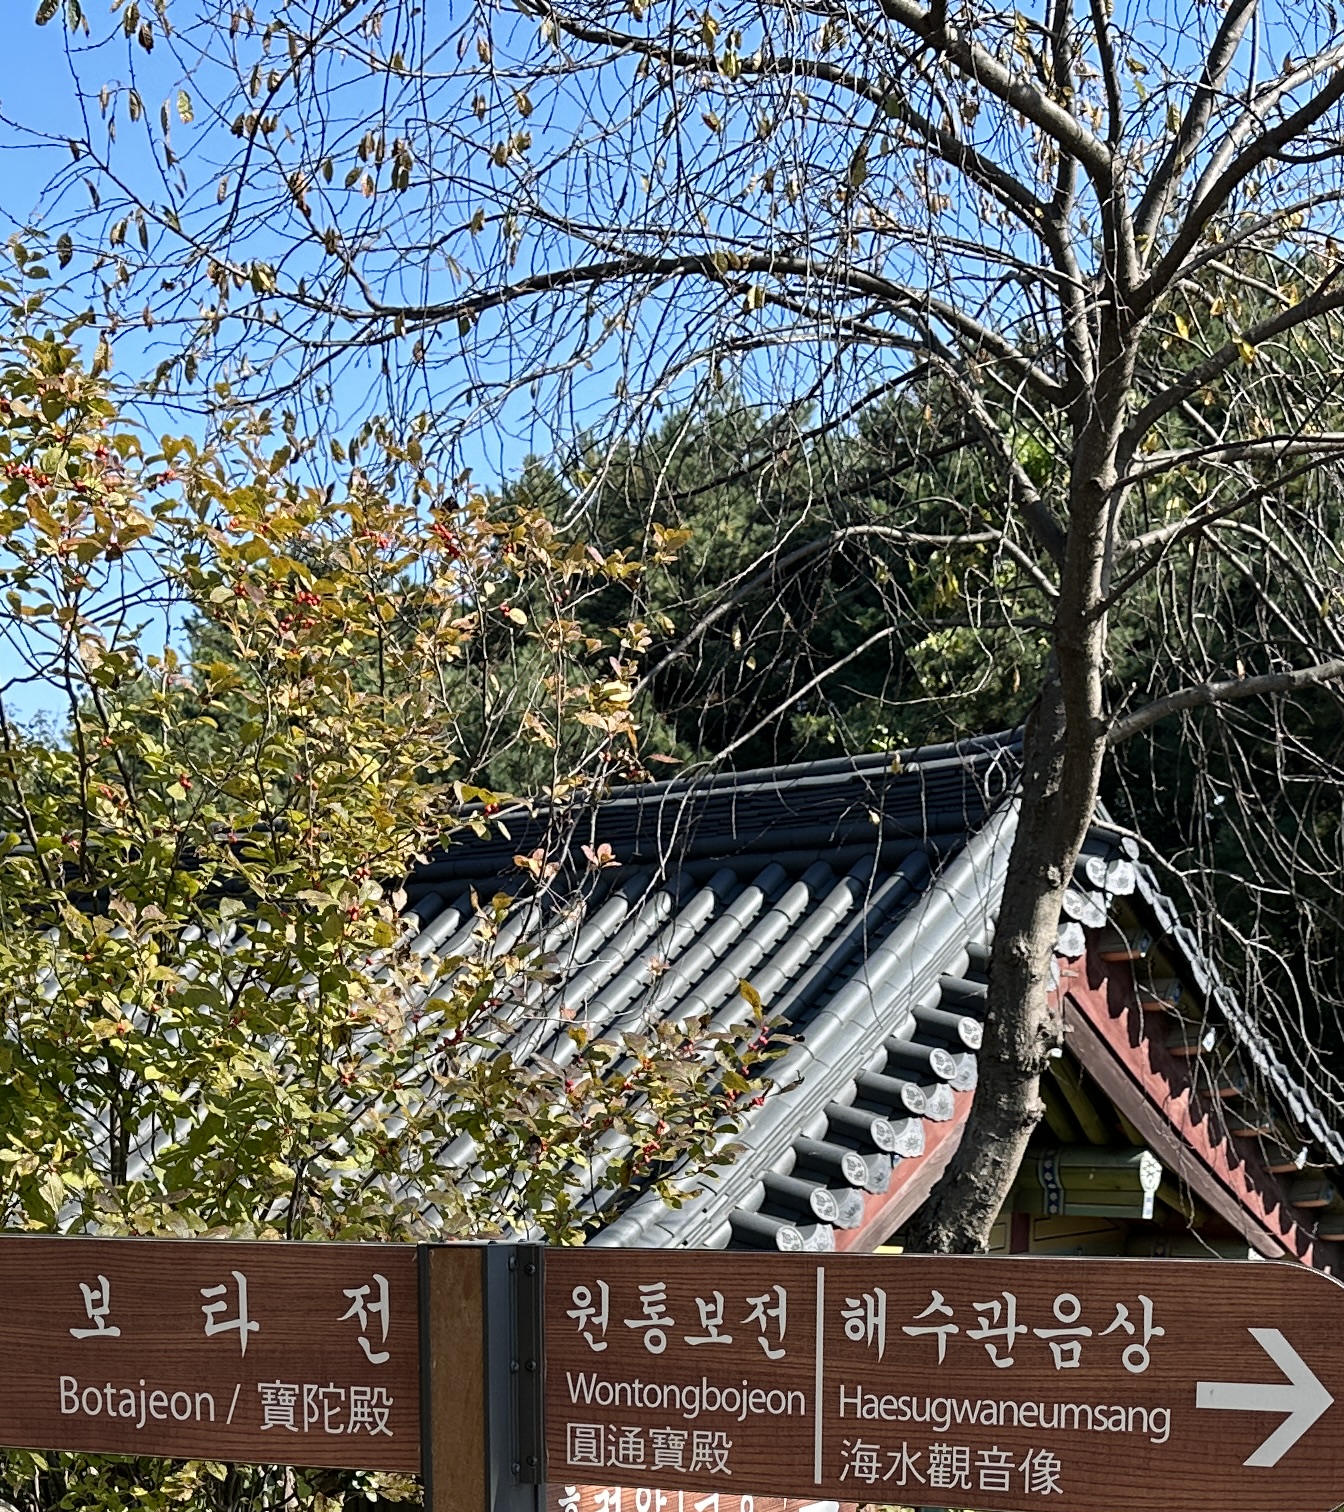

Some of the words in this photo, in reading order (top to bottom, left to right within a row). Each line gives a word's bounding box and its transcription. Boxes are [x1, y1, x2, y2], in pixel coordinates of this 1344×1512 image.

[566, 1279, 788, 1360] 원통보전
[840, 1287, 1166, 1374] 해수관음상
[59, 1375, 216, 1429] Botajeon
[257, 1379, 394, 1437] 寶陀殿
[565, 1371, 806, 1422] Wontongbojeon
[838, 1384, 1172, 1444] Haesugwaneumsang
[566, 1421, 733, 1475] 圓通寶殿
[838, 1438, 1065, 1496] 海水觀音像
